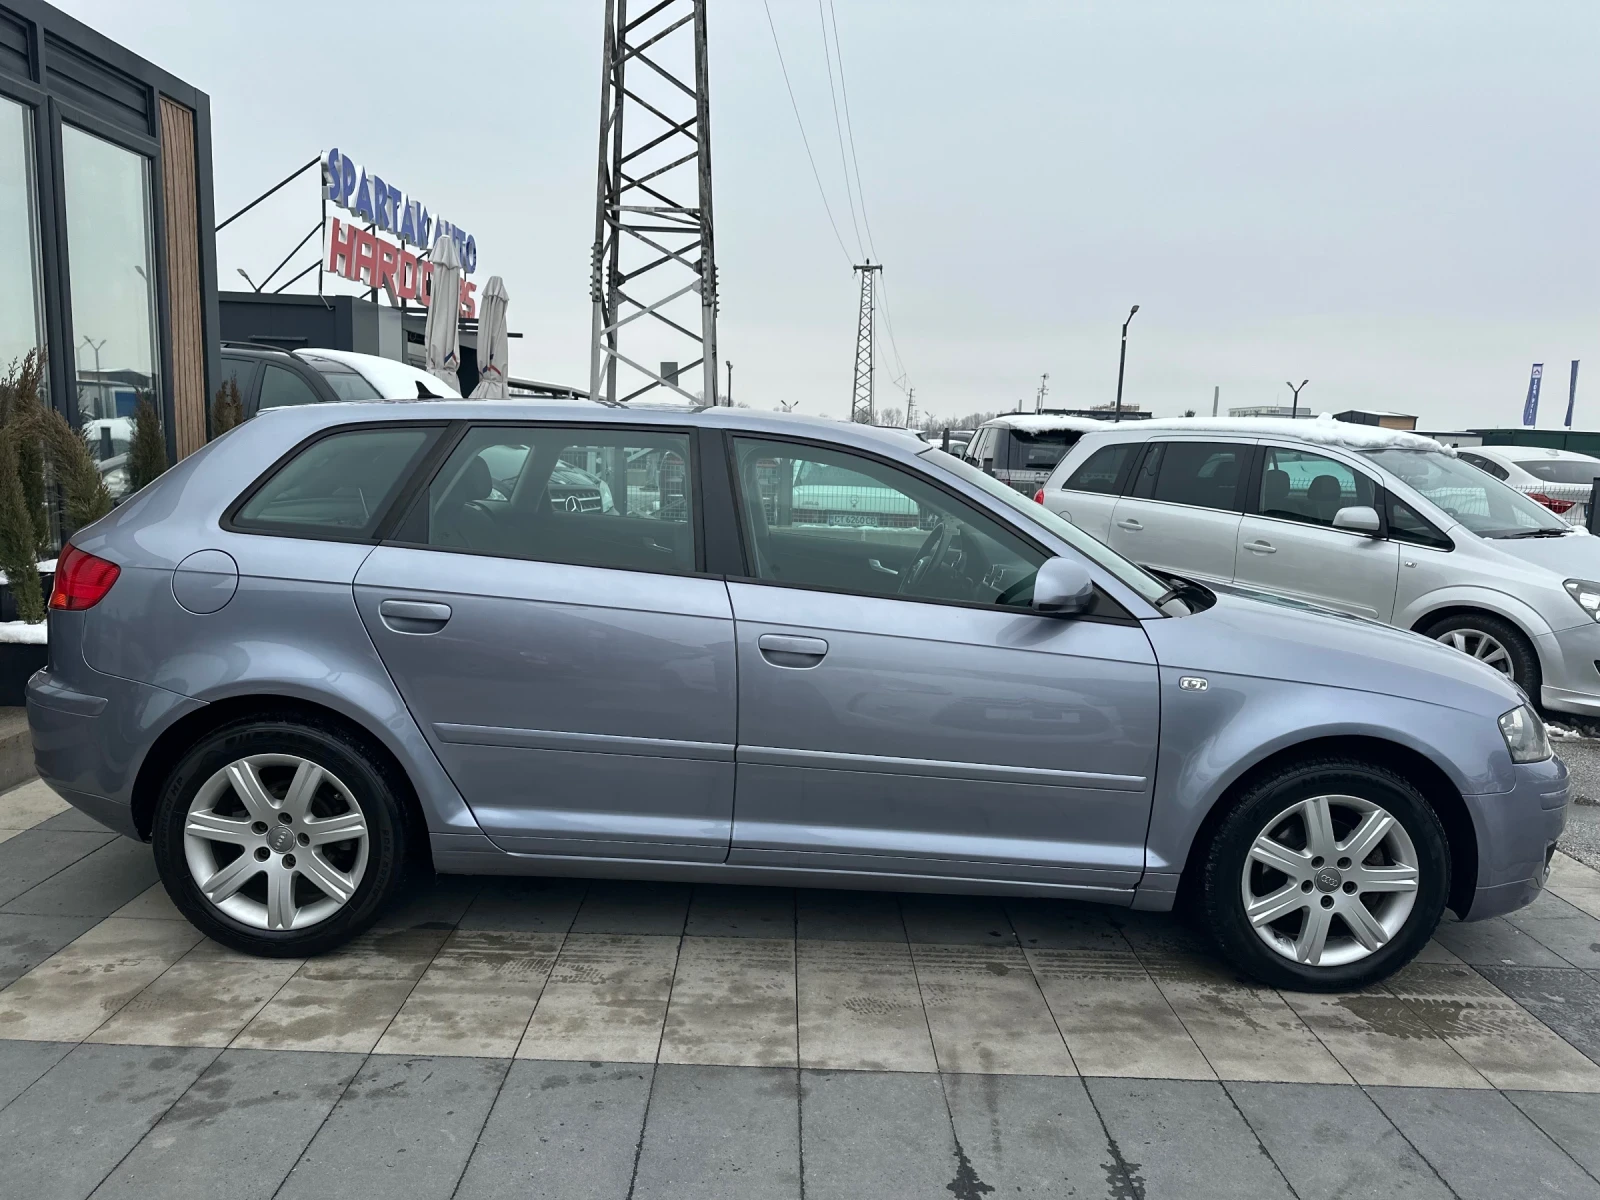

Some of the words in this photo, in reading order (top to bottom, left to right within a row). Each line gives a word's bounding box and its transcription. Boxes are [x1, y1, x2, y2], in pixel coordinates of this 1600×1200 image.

[322, 147, 430, 250] SPARTAK
[324, 216, 417, 306] HARD
[417, 259, 477, 318] CS
[834, 515, 845, 523] CT
[845, 515, 865, 524] 6260
